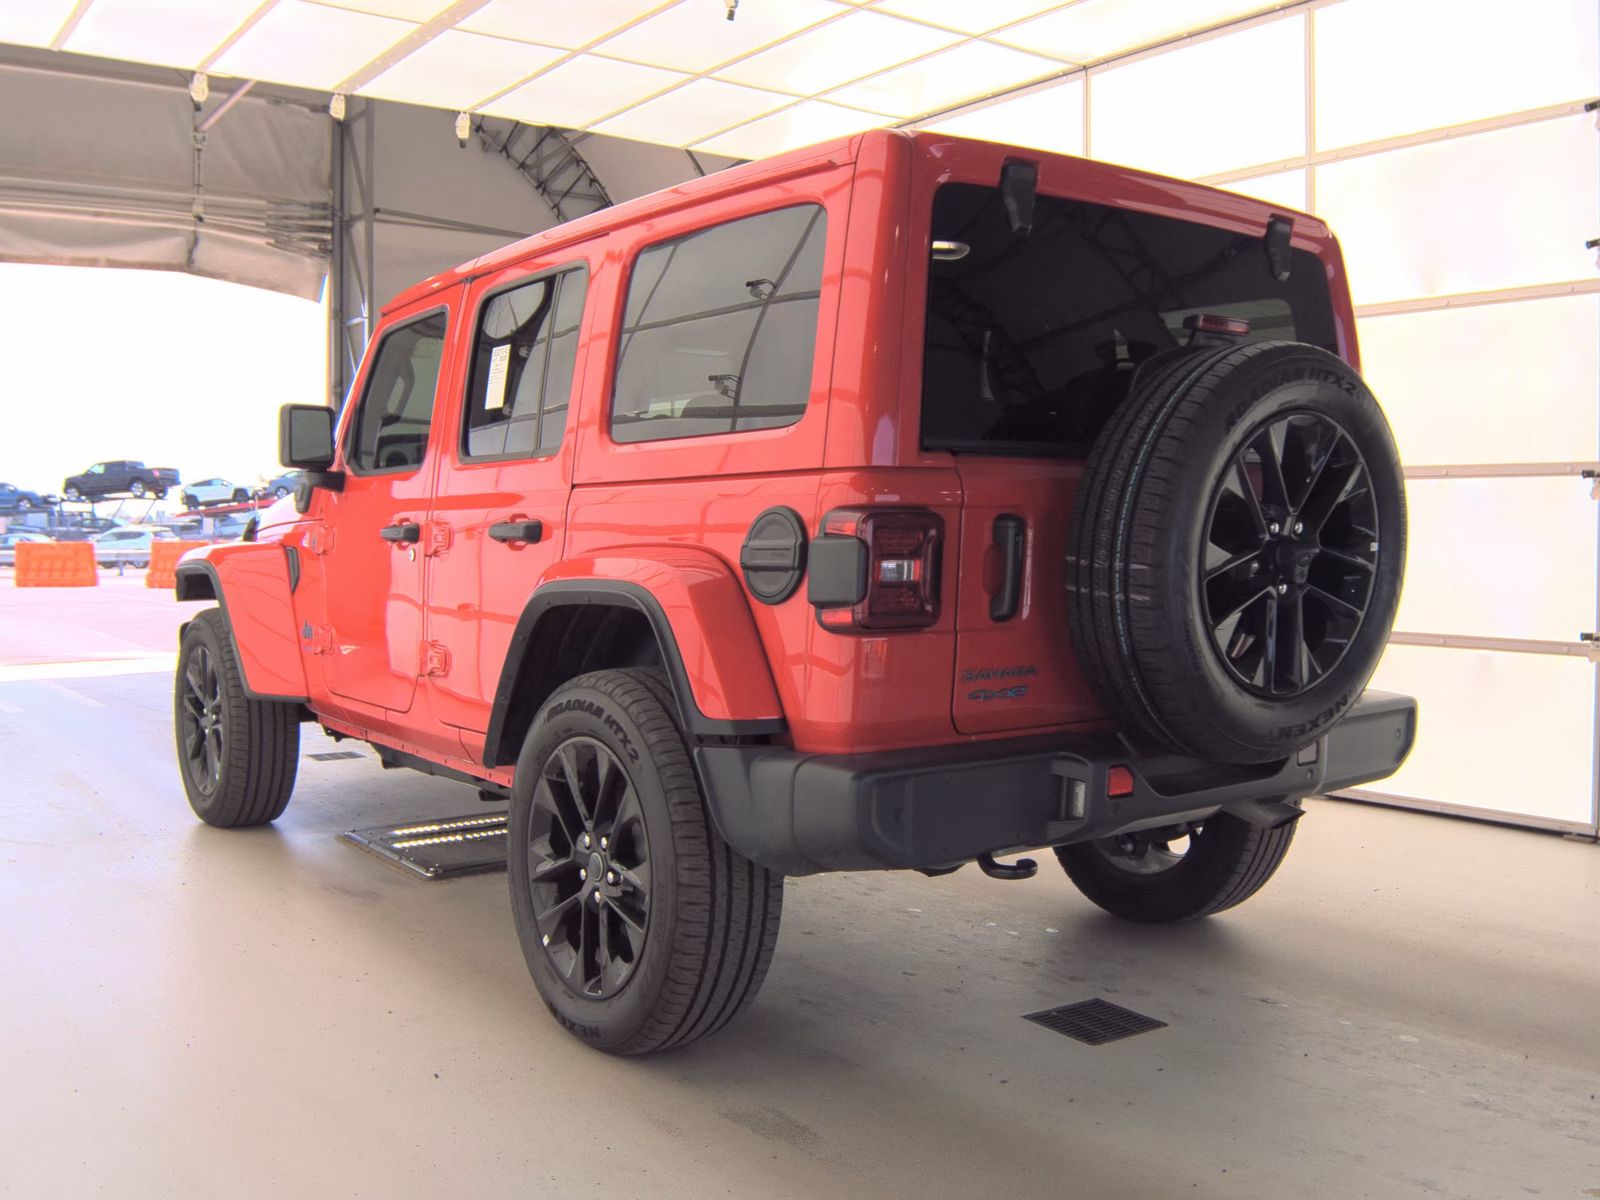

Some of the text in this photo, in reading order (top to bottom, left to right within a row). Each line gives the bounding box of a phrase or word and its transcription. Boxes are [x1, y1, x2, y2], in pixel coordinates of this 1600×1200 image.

[1307, 367, 1358, 397] HTX2
[1278, 692, 1348, 738] NEXEN
[603, 713, 640, 764] HTX2
